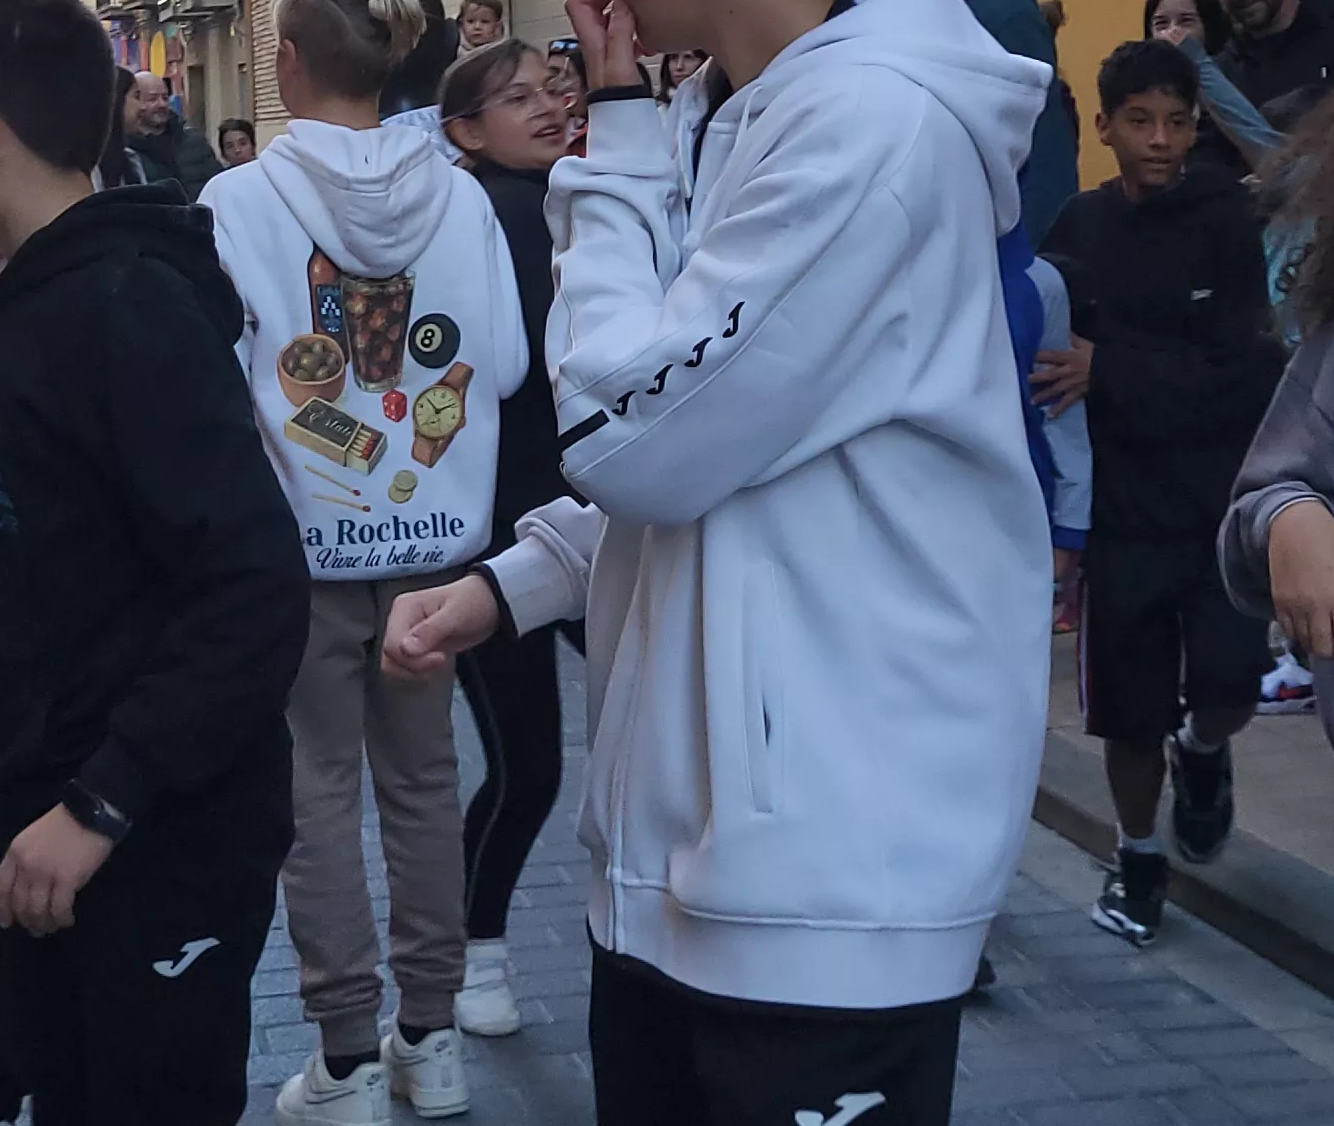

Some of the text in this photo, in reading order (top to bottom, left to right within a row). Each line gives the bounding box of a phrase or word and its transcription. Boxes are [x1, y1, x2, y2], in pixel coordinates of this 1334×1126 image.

[301, 511, 466, 547] a Rochelle
[364, 546, 382, 568] la
[386, 544, 421, 567] belle
